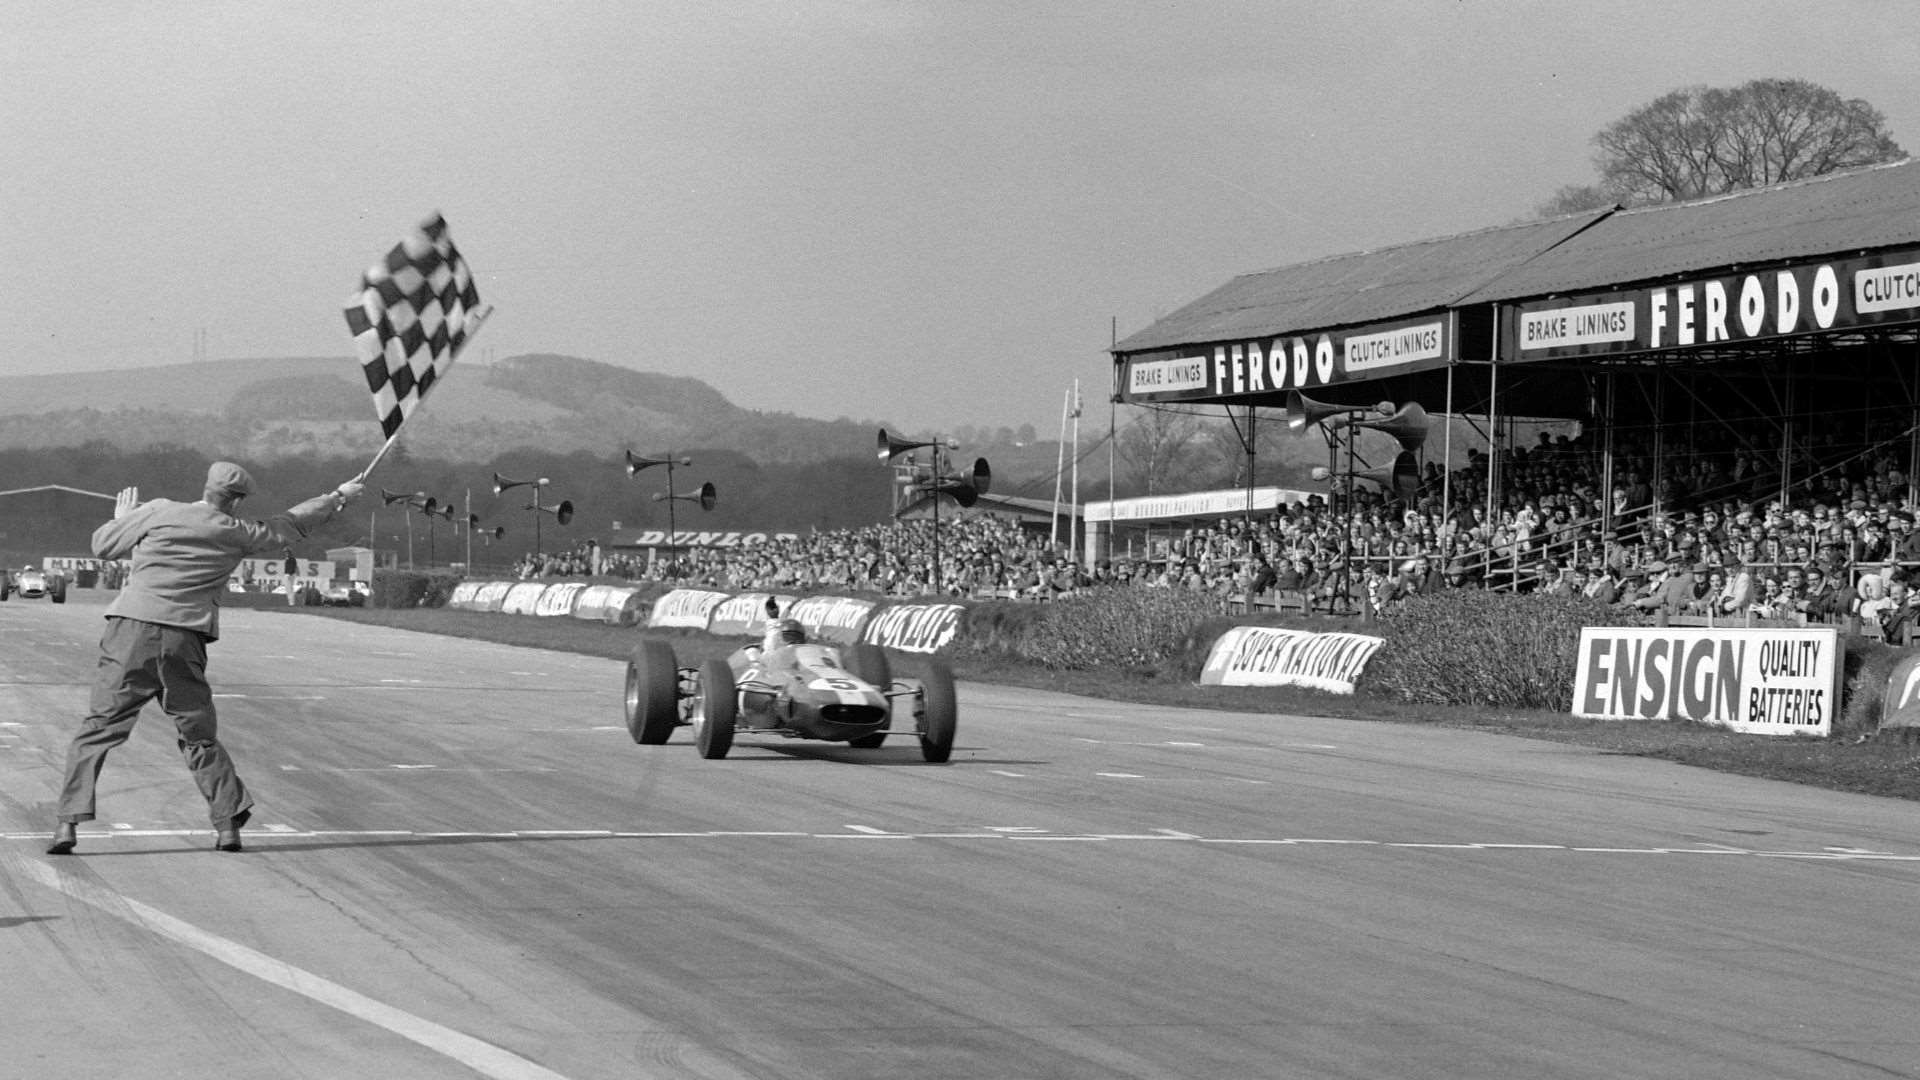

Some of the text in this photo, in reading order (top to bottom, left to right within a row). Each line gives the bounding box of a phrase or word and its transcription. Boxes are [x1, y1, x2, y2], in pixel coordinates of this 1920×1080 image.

[1527, 310, 1627, 341] BRAKE LININGS
[1651, 264, 1839, 348] FERODO
[1214, 333, 1334, 395] FERODO
[1350, 329, 1438, 363] CLUTCH LININGS
[1134, 363, 1202, 387] BRAKE LININGS
[1232, 629, 1375, 684] SUPER NATIONAL
[1759, 639, 1821, 683] QUALITY
[1583, 638, 1746, 722] ENSIGN
[1749, 687, 1824, 726] BATTERIES
